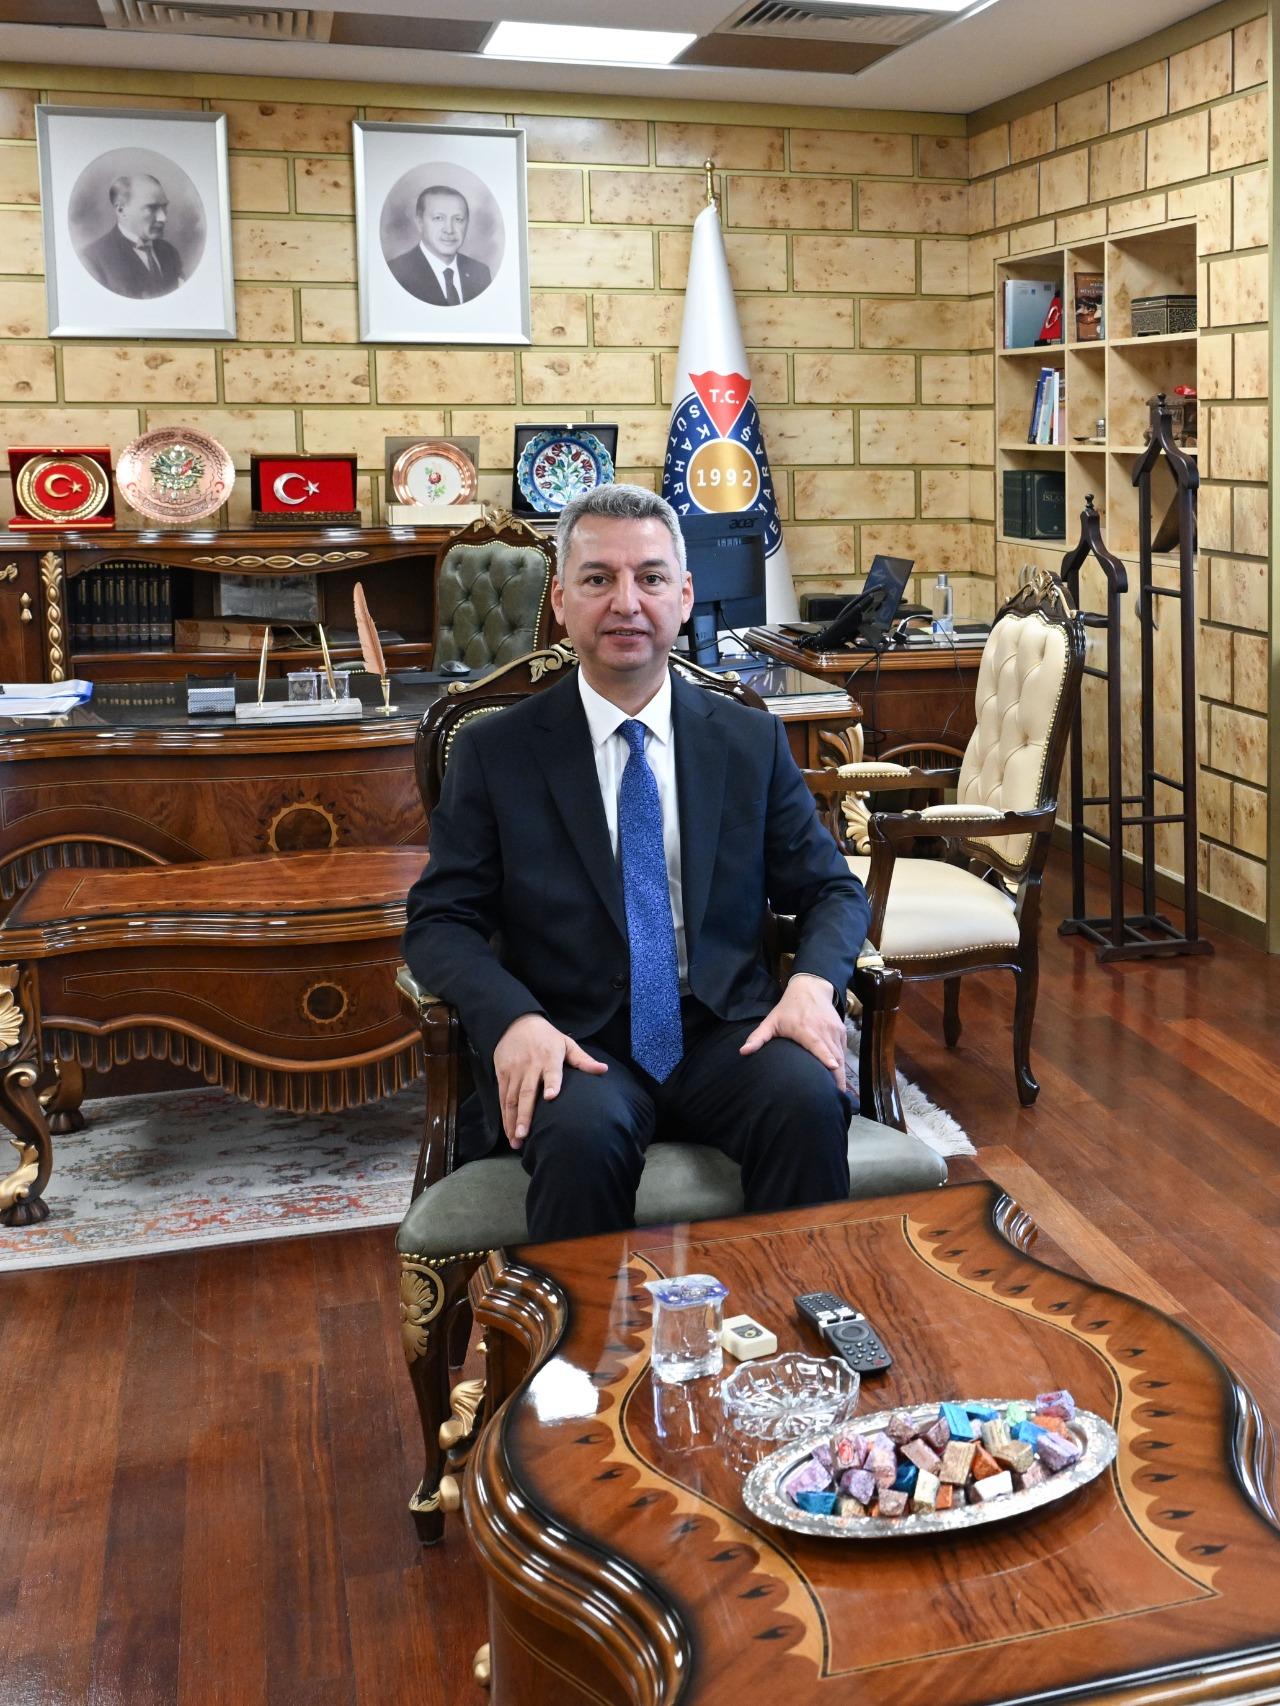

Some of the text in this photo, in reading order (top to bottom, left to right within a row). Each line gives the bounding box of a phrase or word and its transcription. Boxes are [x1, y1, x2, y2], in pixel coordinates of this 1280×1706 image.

[708, 388, 740, 405] T.C.
[696, 468, 752, 488] 1992
[728, 518, 759, 530] acer
